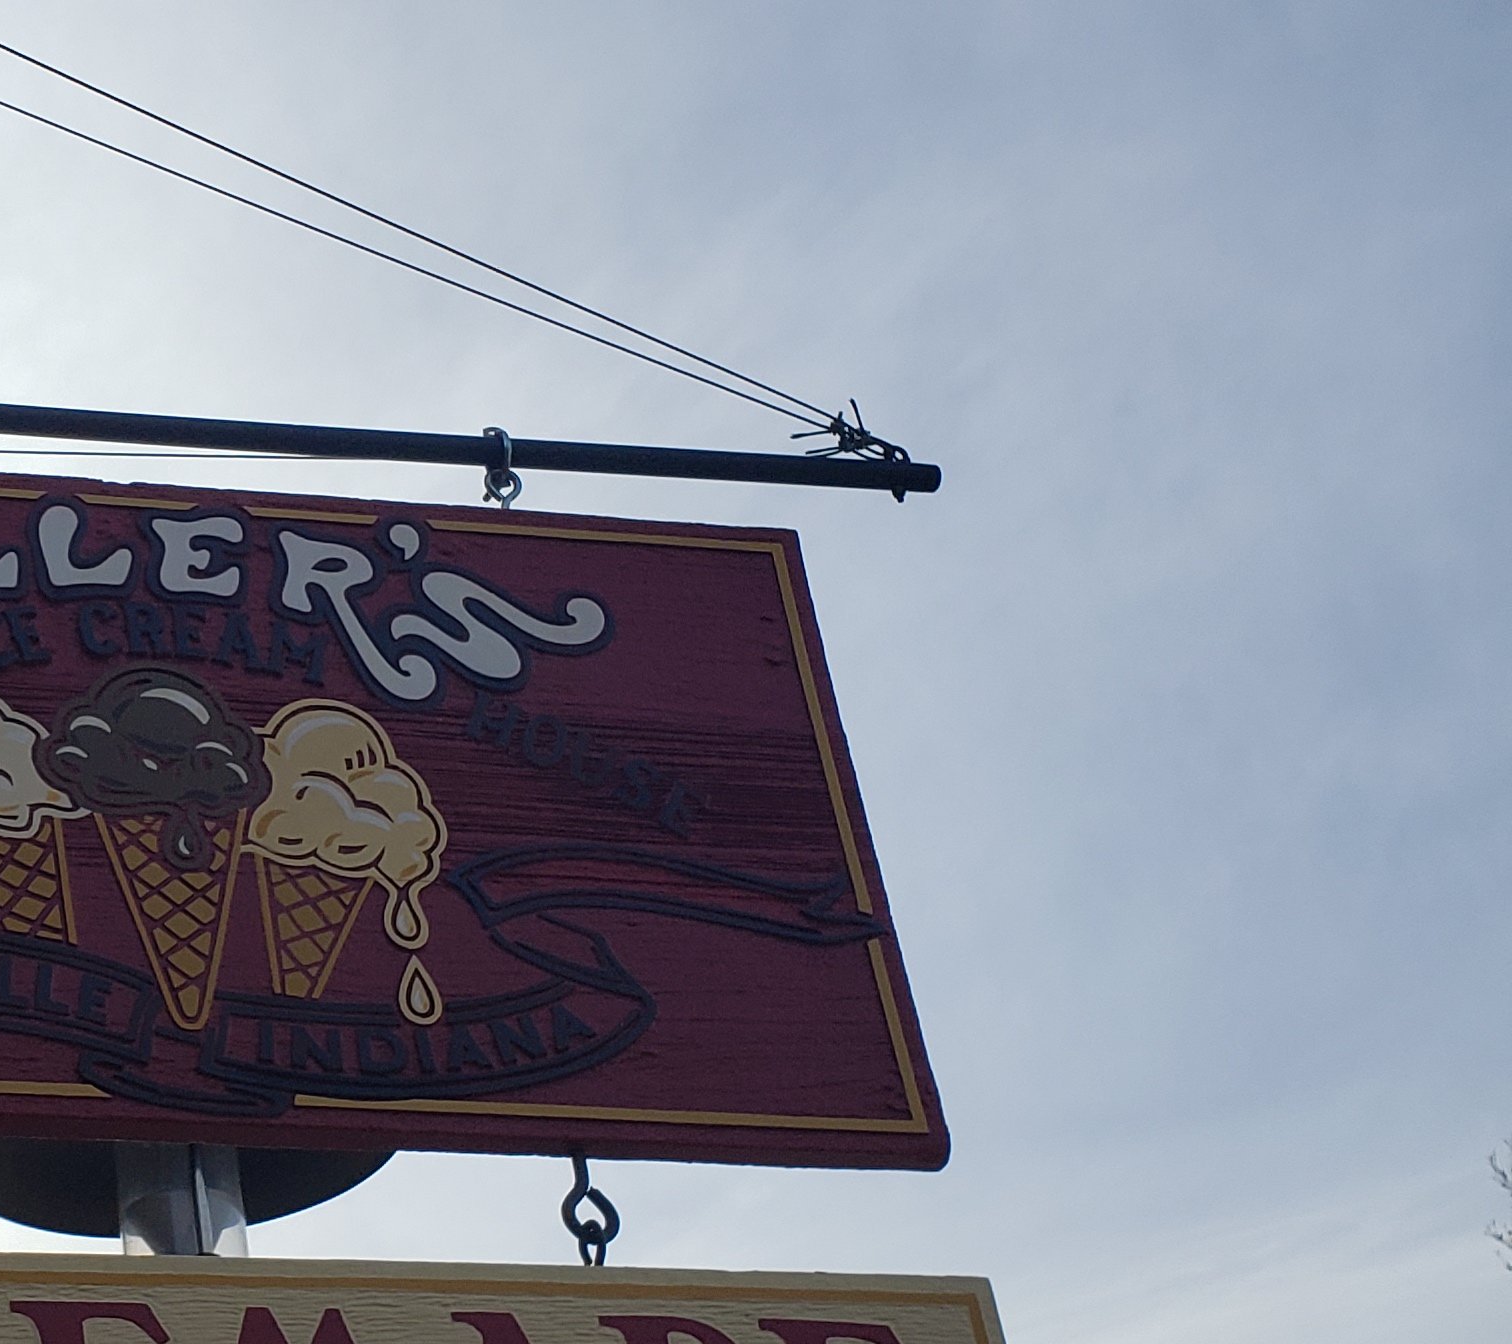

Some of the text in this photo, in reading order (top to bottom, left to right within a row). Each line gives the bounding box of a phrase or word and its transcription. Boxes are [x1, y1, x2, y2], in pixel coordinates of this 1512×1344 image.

[78, 597, 333, 687] CREAM
[465, 688, 712, 839] HOUSE
[251, 1003, 598, 1076] INDIANA
